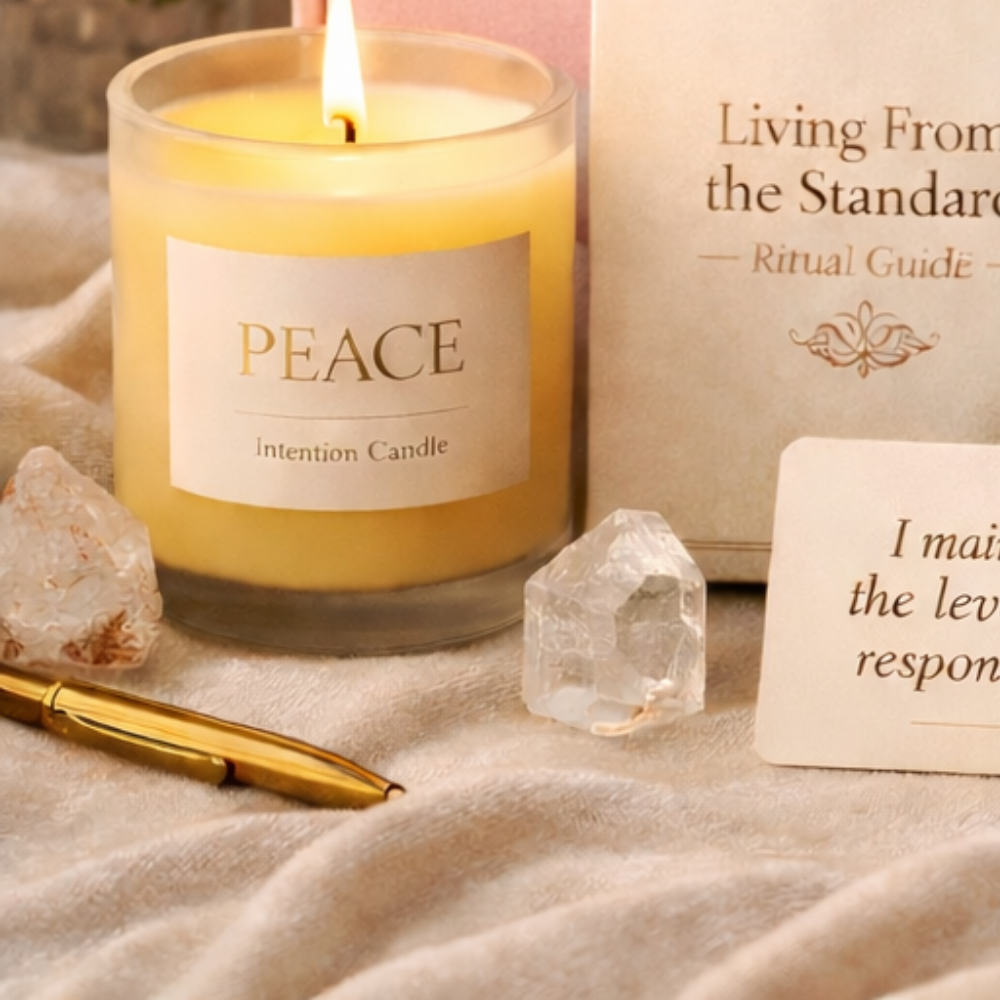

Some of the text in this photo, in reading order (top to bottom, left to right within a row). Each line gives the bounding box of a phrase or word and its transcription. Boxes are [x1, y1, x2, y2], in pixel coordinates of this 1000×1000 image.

[718, 102, 867, 163] Living
[705, 163, 782, 213] the
[751, 242, 855, 277] Ritual
[237, 318, 465, 383] PEACE
[256, 435, 449, 463] Intention Candle
[890, 518, 912, 558] I
[848, 573, 915, 618] the
